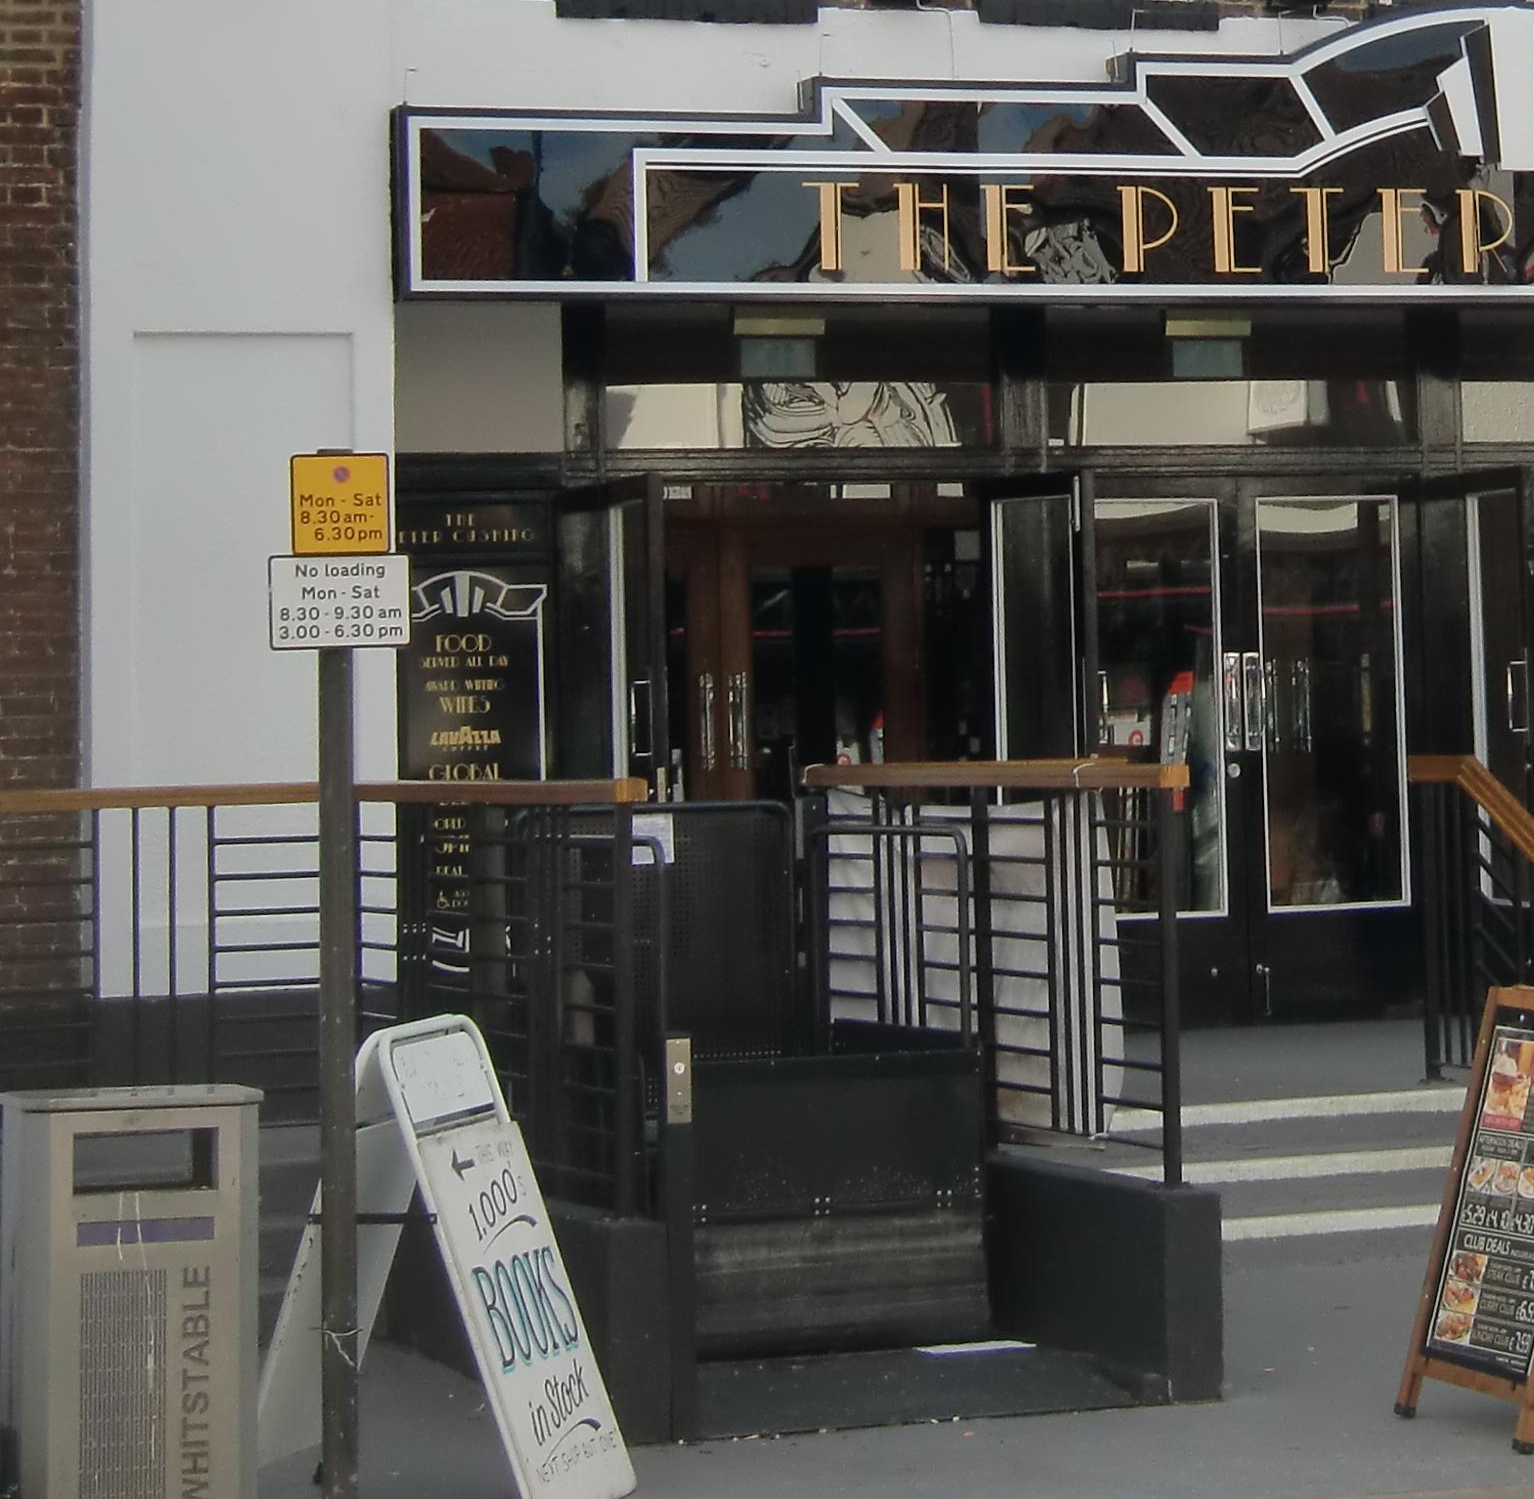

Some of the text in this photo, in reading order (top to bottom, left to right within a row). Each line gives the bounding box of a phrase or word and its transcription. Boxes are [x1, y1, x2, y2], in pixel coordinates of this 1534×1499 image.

[801, 181, 1034, 273] THE
[1117, 183, 1515, 277] PETER
[300, 494, 335, 508] Mon
[353, 493, 382, 507] Sat
[295, 563, 386, 579] No loading
[302, 587, 337, 601] Mon
[351, 585, 381, 599] Sat
[280, 607, 320, 621] 8.30
[334, 605, 374, 620] 9.30
[279, 625, 320, 640] 3.00
[334, 624, 374, 639] 6.30
[435, 634, 492, 652] FOOD
[430, 726, 501, 746] LAVAZZA
[428, 763, 502, 781] GLOBAL
[471, 1245, 580, 1374] BOOKS
[529, 1358, 590, 1446] in Stock
